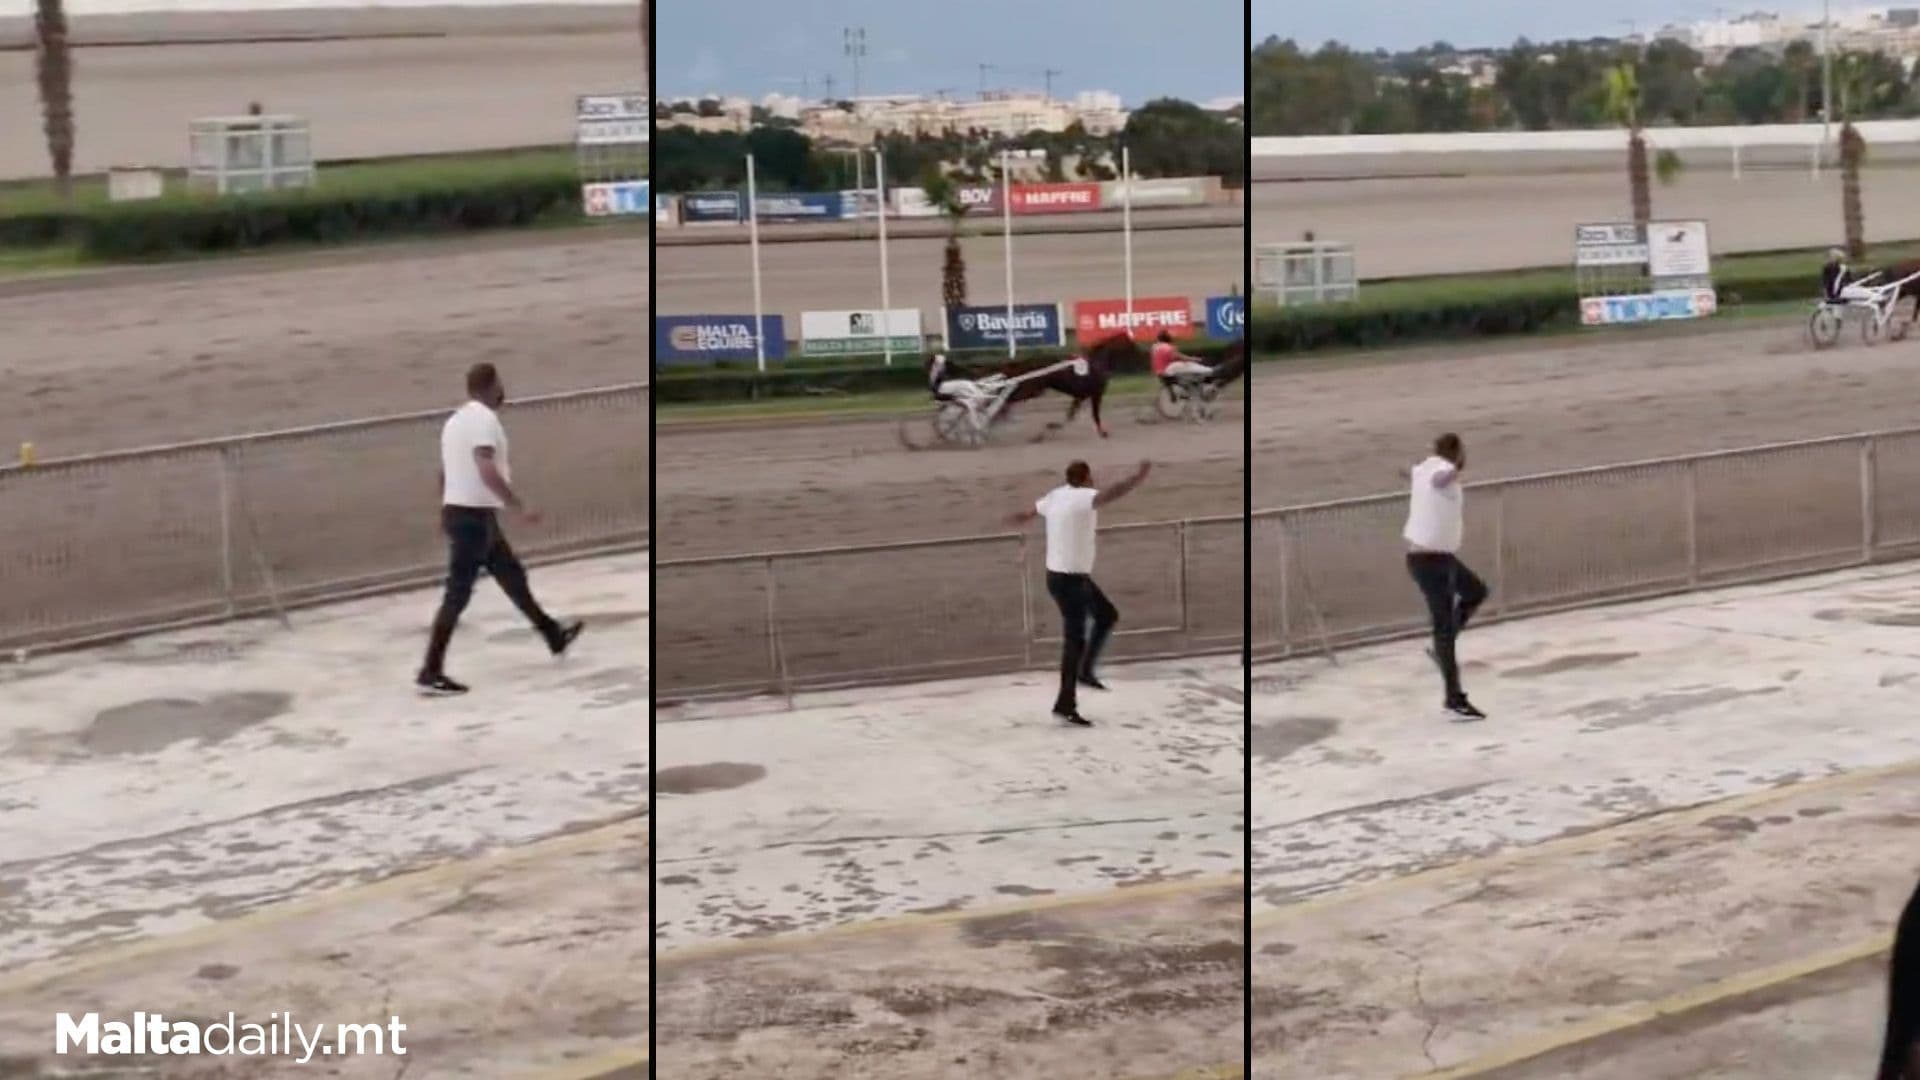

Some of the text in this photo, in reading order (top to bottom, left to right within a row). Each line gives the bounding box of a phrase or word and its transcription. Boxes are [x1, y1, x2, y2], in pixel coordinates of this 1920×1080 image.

[959, 188, 993, 204] BOV
[1025, 190, 1092, 205] MAPFRE
[976, 311, 1048, 331] Bavaria
[1098, 309, 1188, 329] MAPFRE
[697, 324, 751, 337] MALTA
